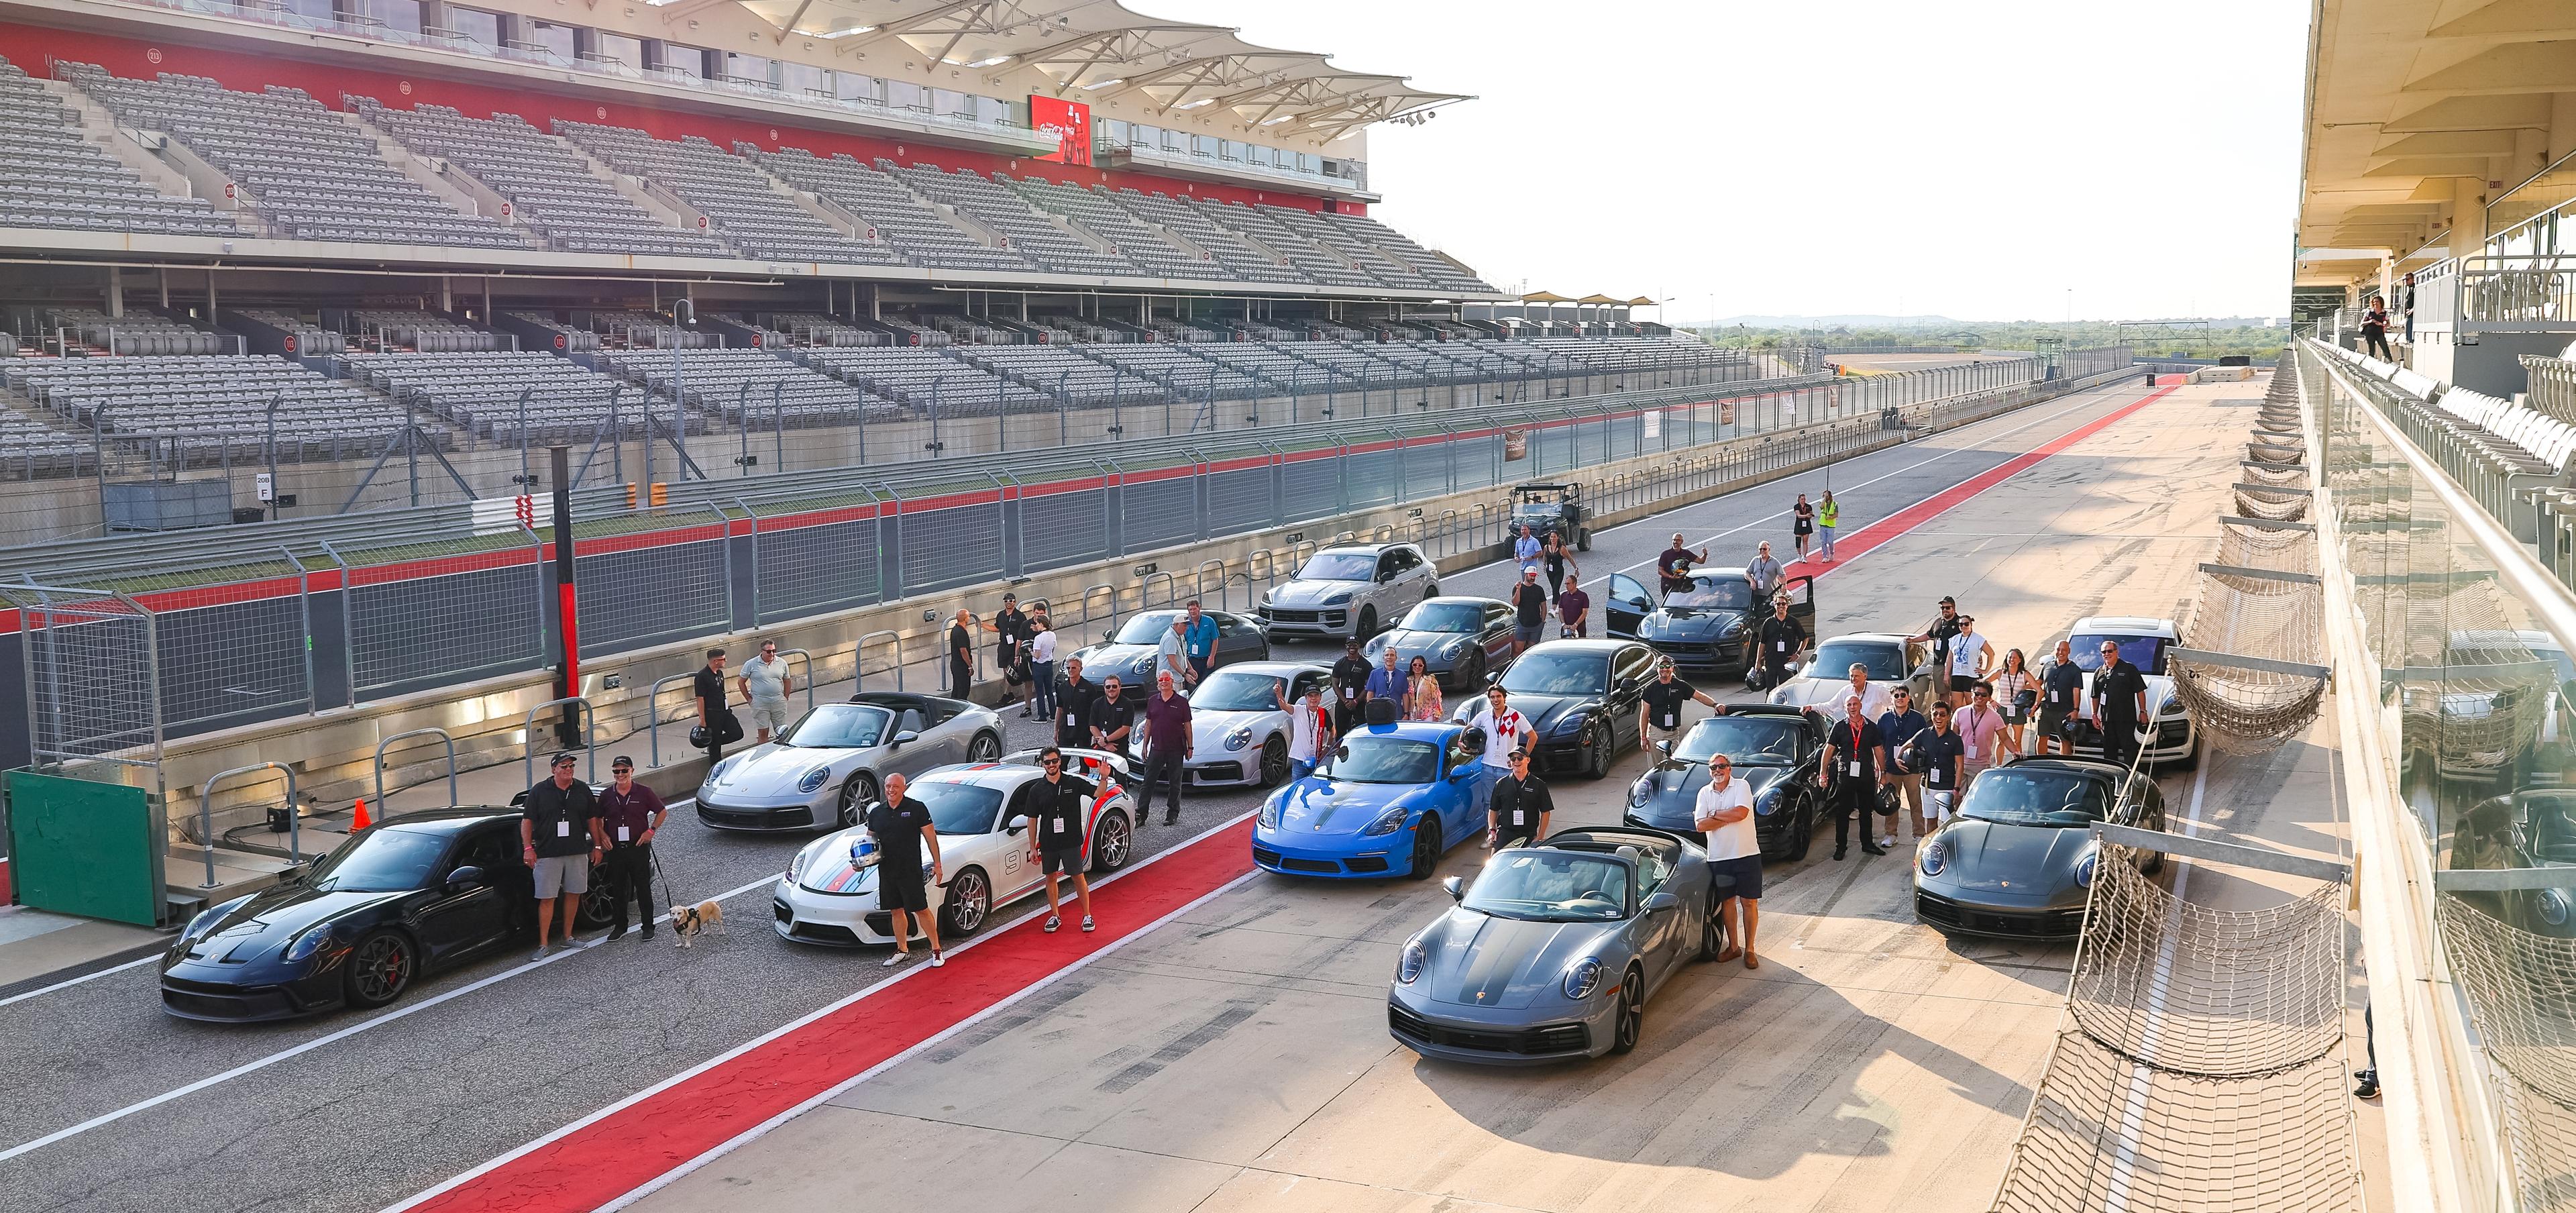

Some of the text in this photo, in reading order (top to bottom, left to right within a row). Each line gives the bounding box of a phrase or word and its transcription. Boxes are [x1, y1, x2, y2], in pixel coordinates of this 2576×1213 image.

[150, 52, 160, 60] 213
[262, 489, 268, 497] F
[1005, 849, 1021, 876] 9
